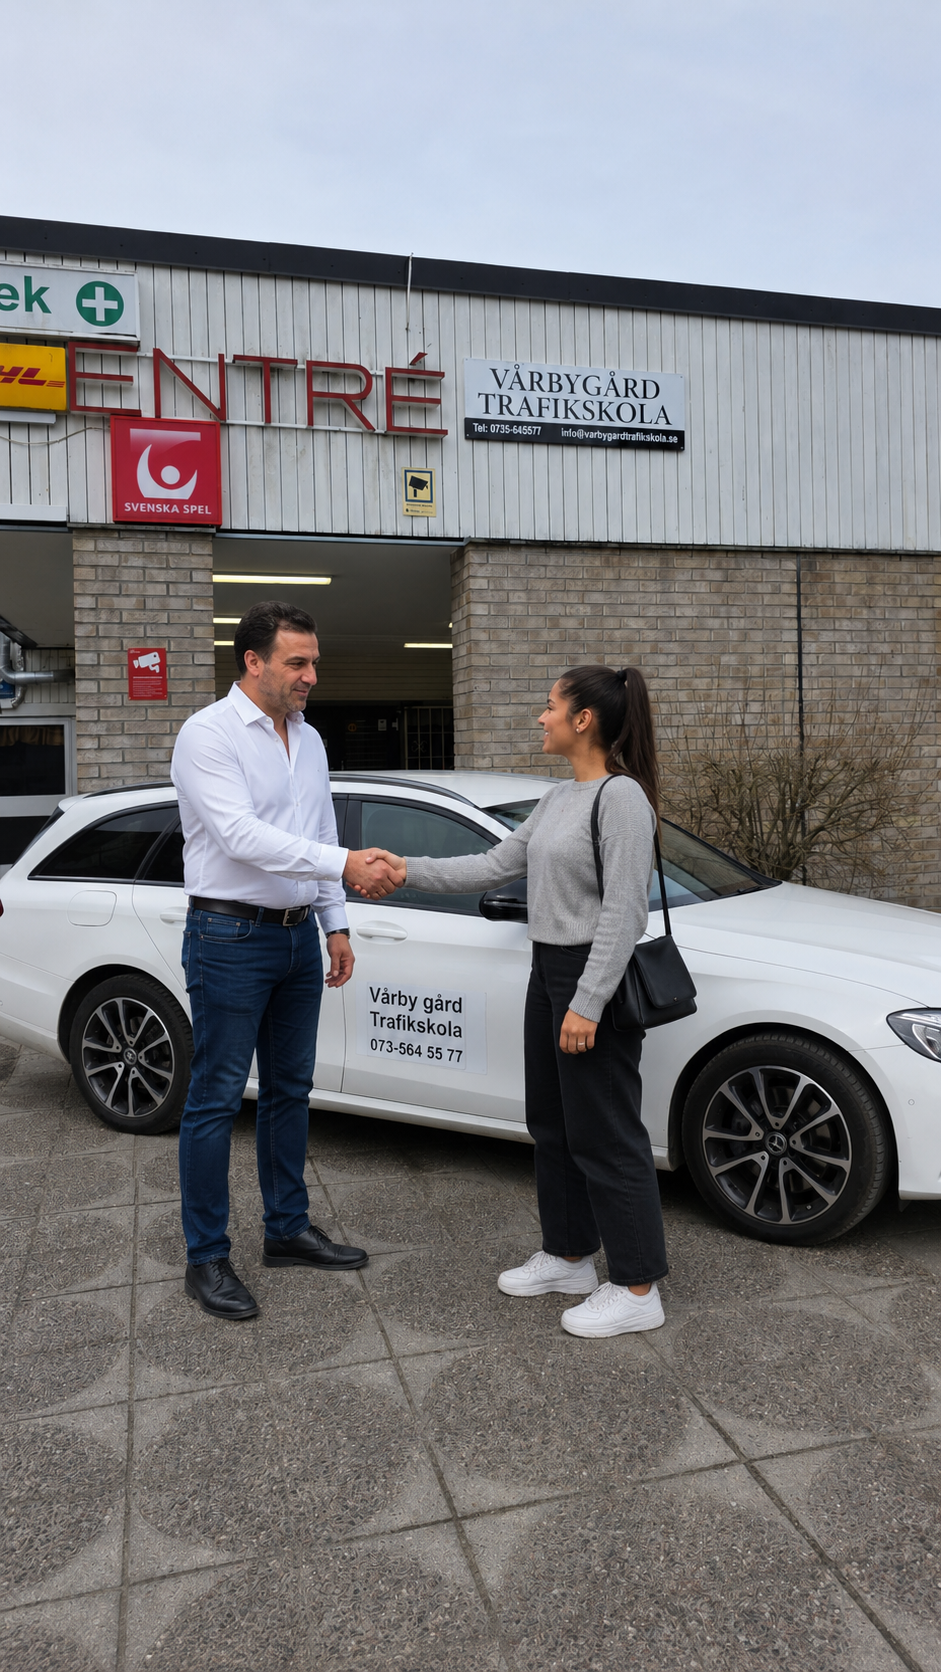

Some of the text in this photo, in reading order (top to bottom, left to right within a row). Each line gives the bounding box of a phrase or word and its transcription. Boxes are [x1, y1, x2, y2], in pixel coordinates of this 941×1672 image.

[67, 341, 449, 436] ENTRÉ
[489, 363, 660, 400] VÅRBYGÅRD
[477, 392, 673, 426] TRAFIKSKOLA
[472, 422, 542, 436] Tel: 0735-645577
[561, 427, 679, 444] info@varbygardtrafikskola.se
[124, 502, 212, 515] SVENSKA SPEL
[369, 986, 463, 1014] Vårby gård
[369, 1011, 463, 1038] Trafikskola
[370, 1038, 463, 1063] 073-564 55 77
